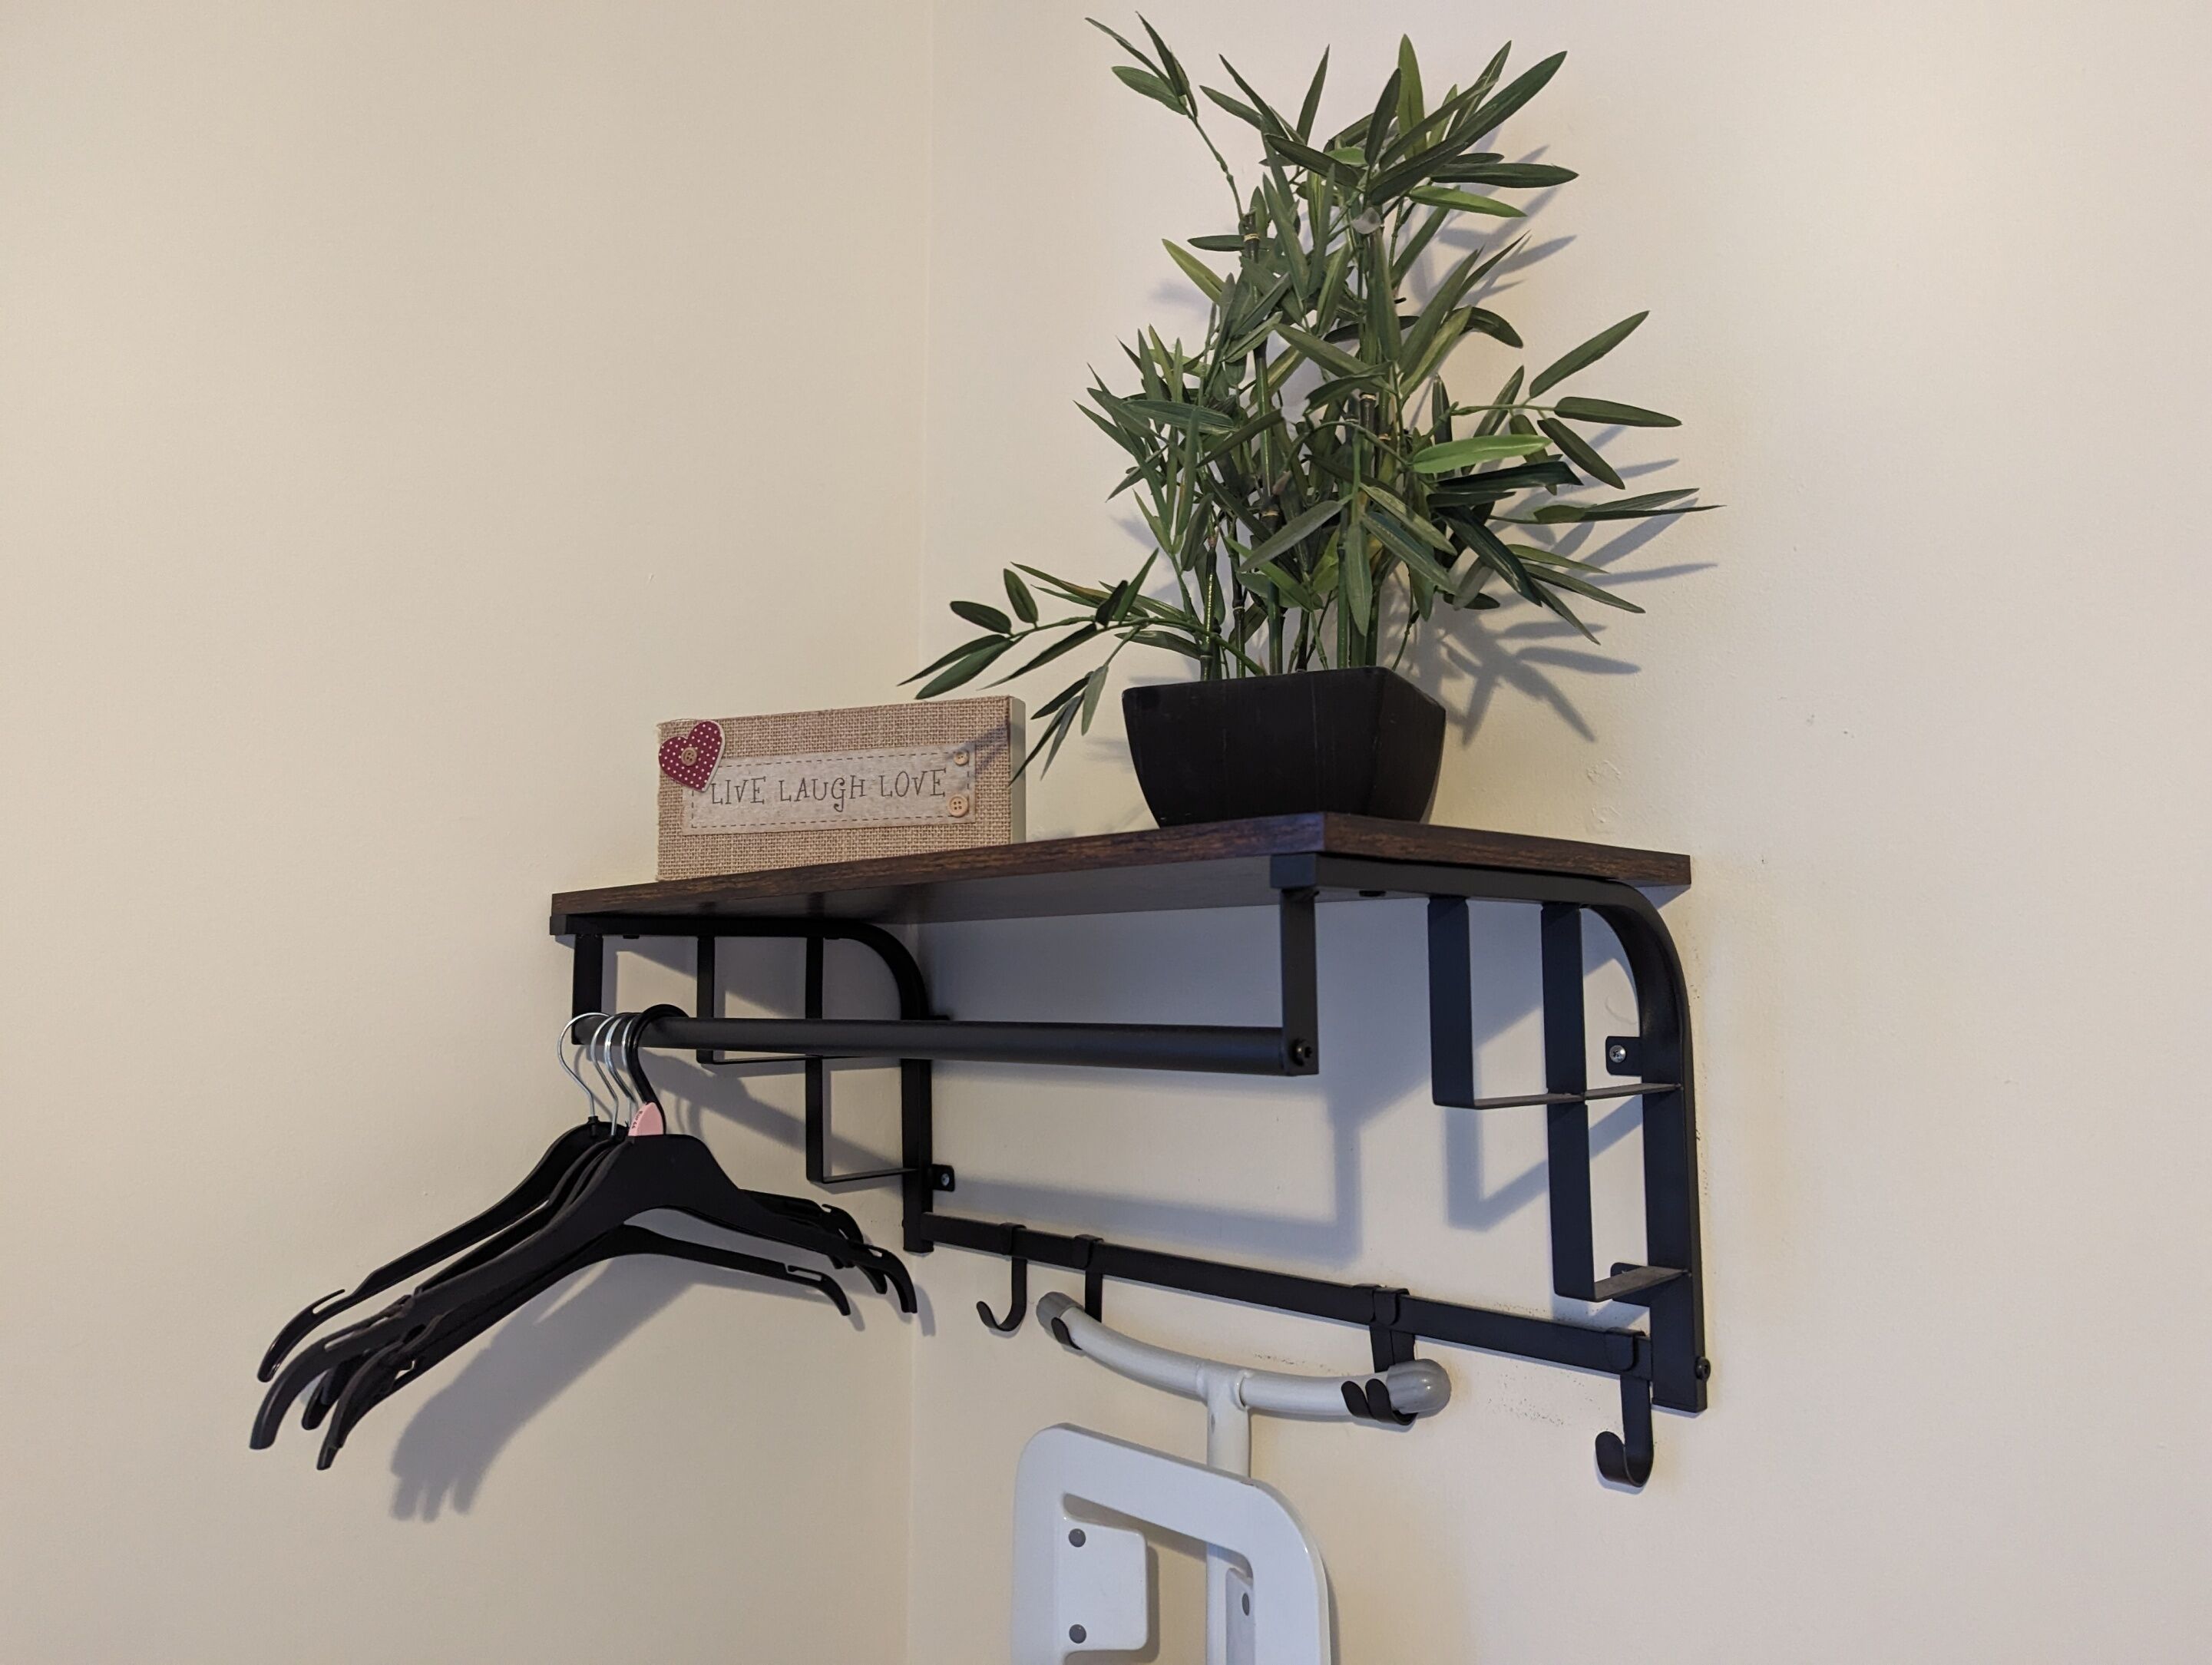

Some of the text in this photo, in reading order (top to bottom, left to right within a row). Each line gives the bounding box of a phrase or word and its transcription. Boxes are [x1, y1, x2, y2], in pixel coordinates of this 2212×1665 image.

[709, 768, 947, 812] LIVE LAUGH LOVE
